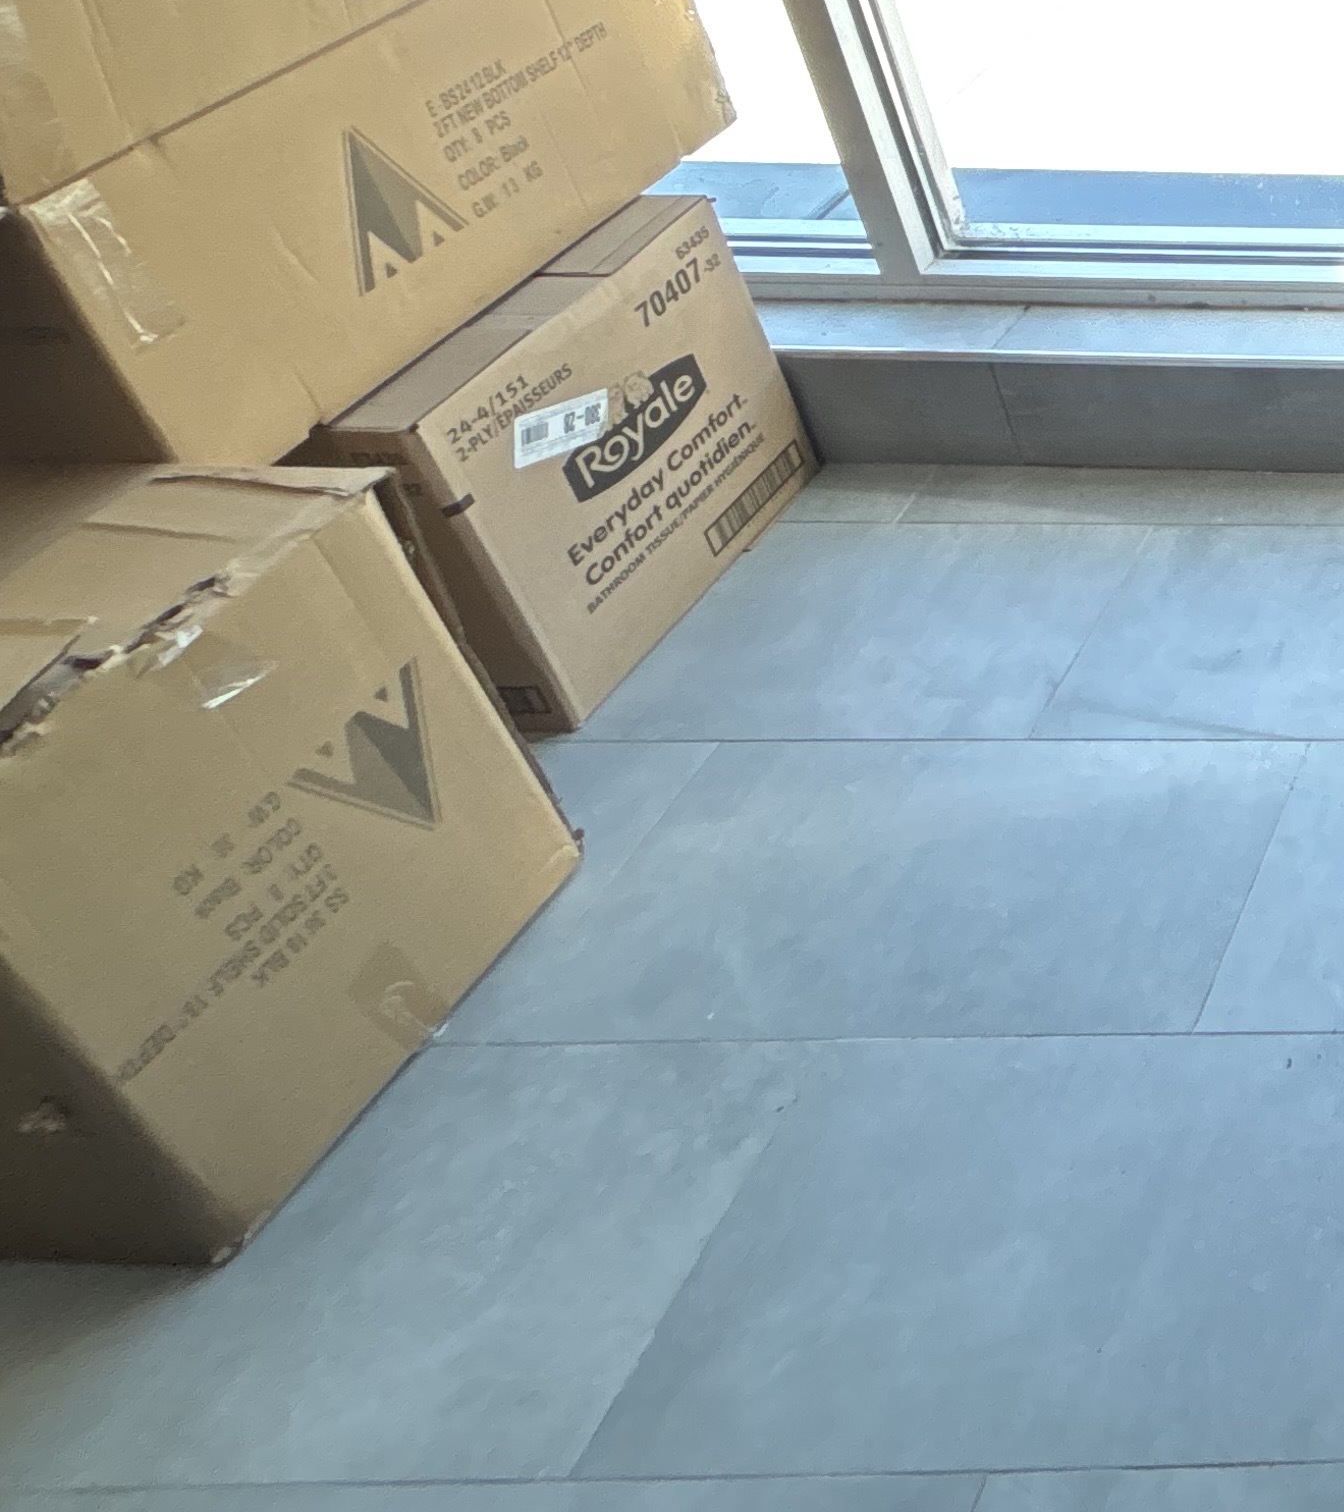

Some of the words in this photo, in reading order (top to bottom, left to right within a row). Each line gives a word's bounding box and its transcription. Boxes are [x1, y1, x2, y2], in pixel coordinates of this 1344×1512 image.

[455, 95, 485, 124] NEW
[480, 69, 529, 109] BOTTOM
[524, 50, 561, 82] SHELF
[572, 21, 609, 53] DEPTH
[485, 109, 513, 137] PCS
[521, 159, 544, 184] KG
[443, 373, 530, 445] 24-4/151
[570, 370, 699, 489] Royale
[563, 463, 671, 568] Everyday
[662, 392, 749, 478] Comfort
[579, 501, 668, 589] Confort
[660, 421, 757, 515] quotidien
[584, 549, 647, 614] BATHROOM
